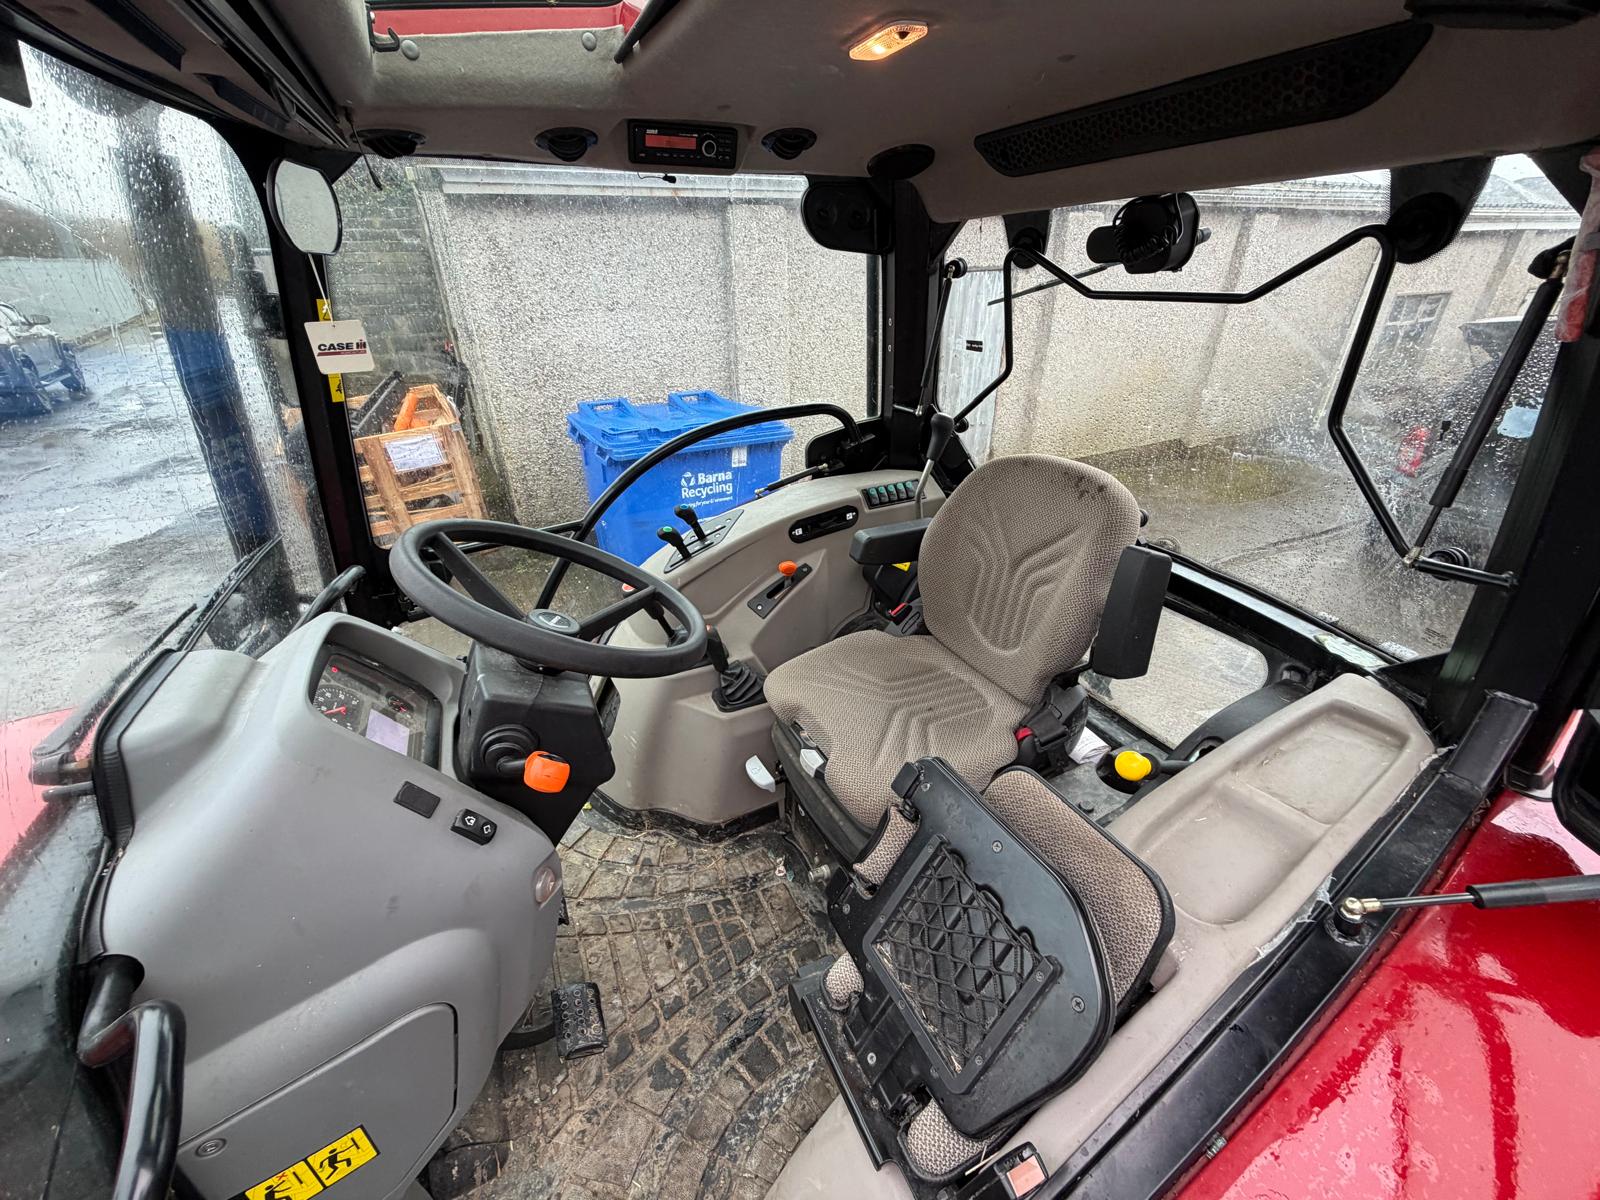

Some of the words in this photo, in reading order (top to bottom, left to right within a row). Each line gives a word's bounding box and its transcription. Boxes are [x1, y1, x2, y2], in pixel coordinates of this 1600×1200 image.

[317, 342, 354, 351] CASE
[697, 471, 732, 485] Barna
[681, 483, 732, 498] Recycling
